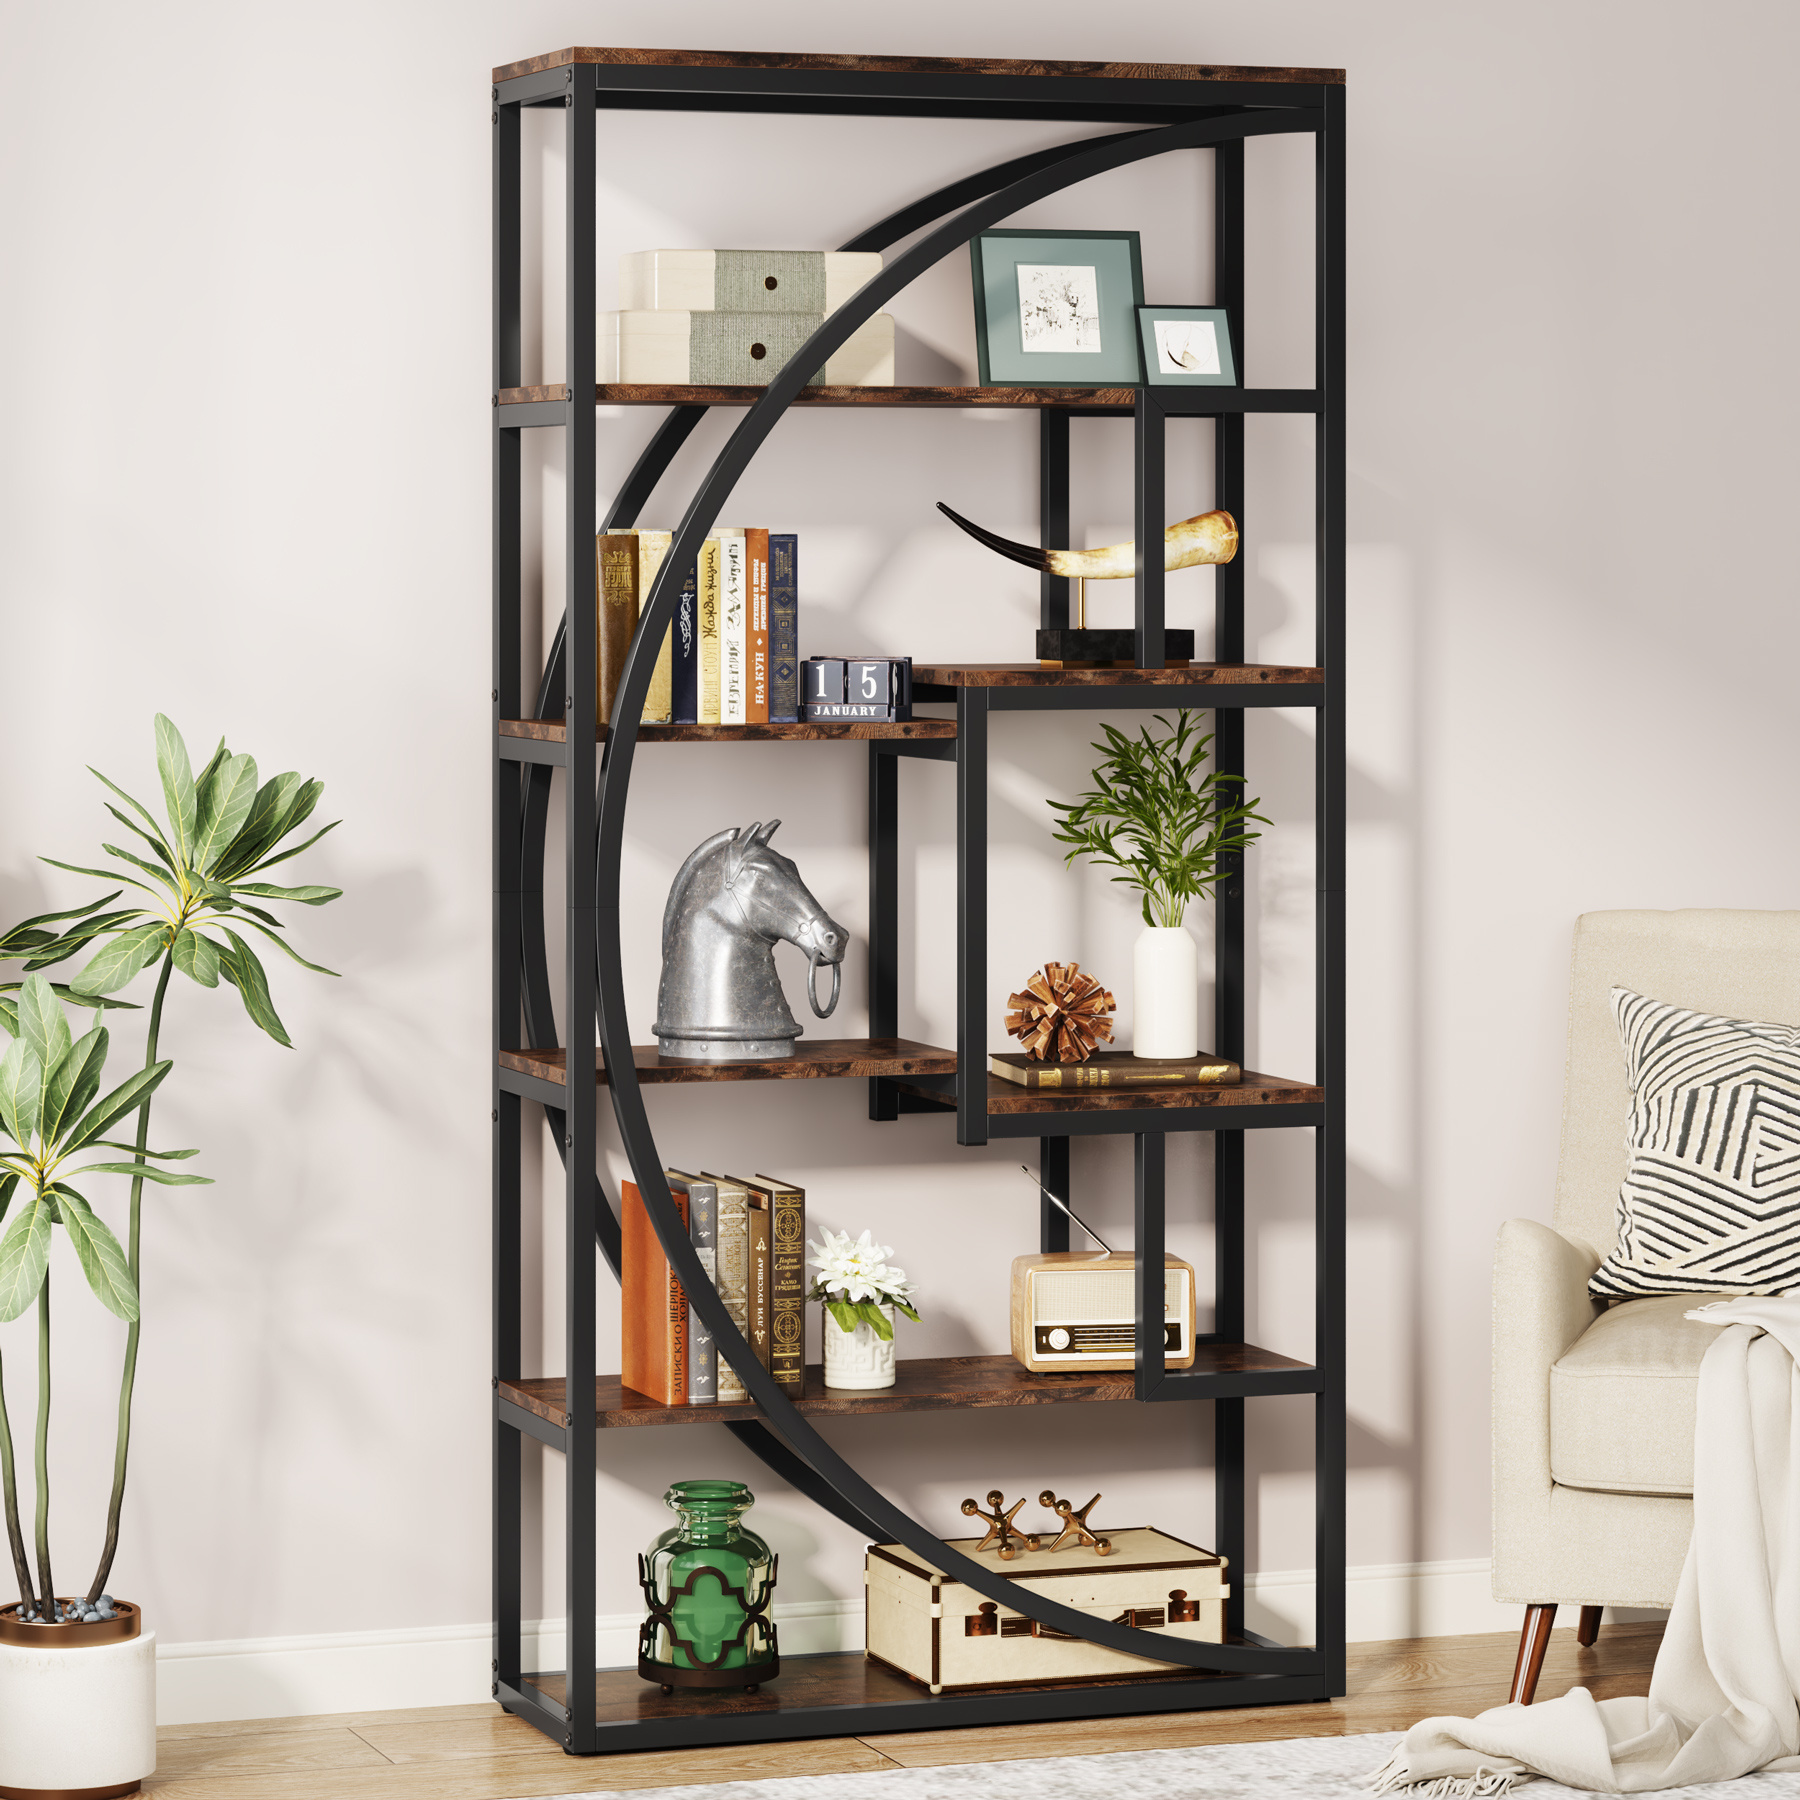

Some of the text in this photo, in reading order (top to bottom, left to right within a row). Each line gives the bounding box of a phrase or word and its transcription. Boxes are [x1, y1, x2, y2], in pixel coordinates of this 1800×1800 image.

[703, 548, 718, 716] ИРВИНГ СТОУН Жажда жизни
[814, 706, 877, 716] JANUARY
[816, 663, 827, 697] 1
[861, 665, 877, 699] 5
[670, 1266, 683, 1396] ЗАПИСКИ О ШЕРЛОК
